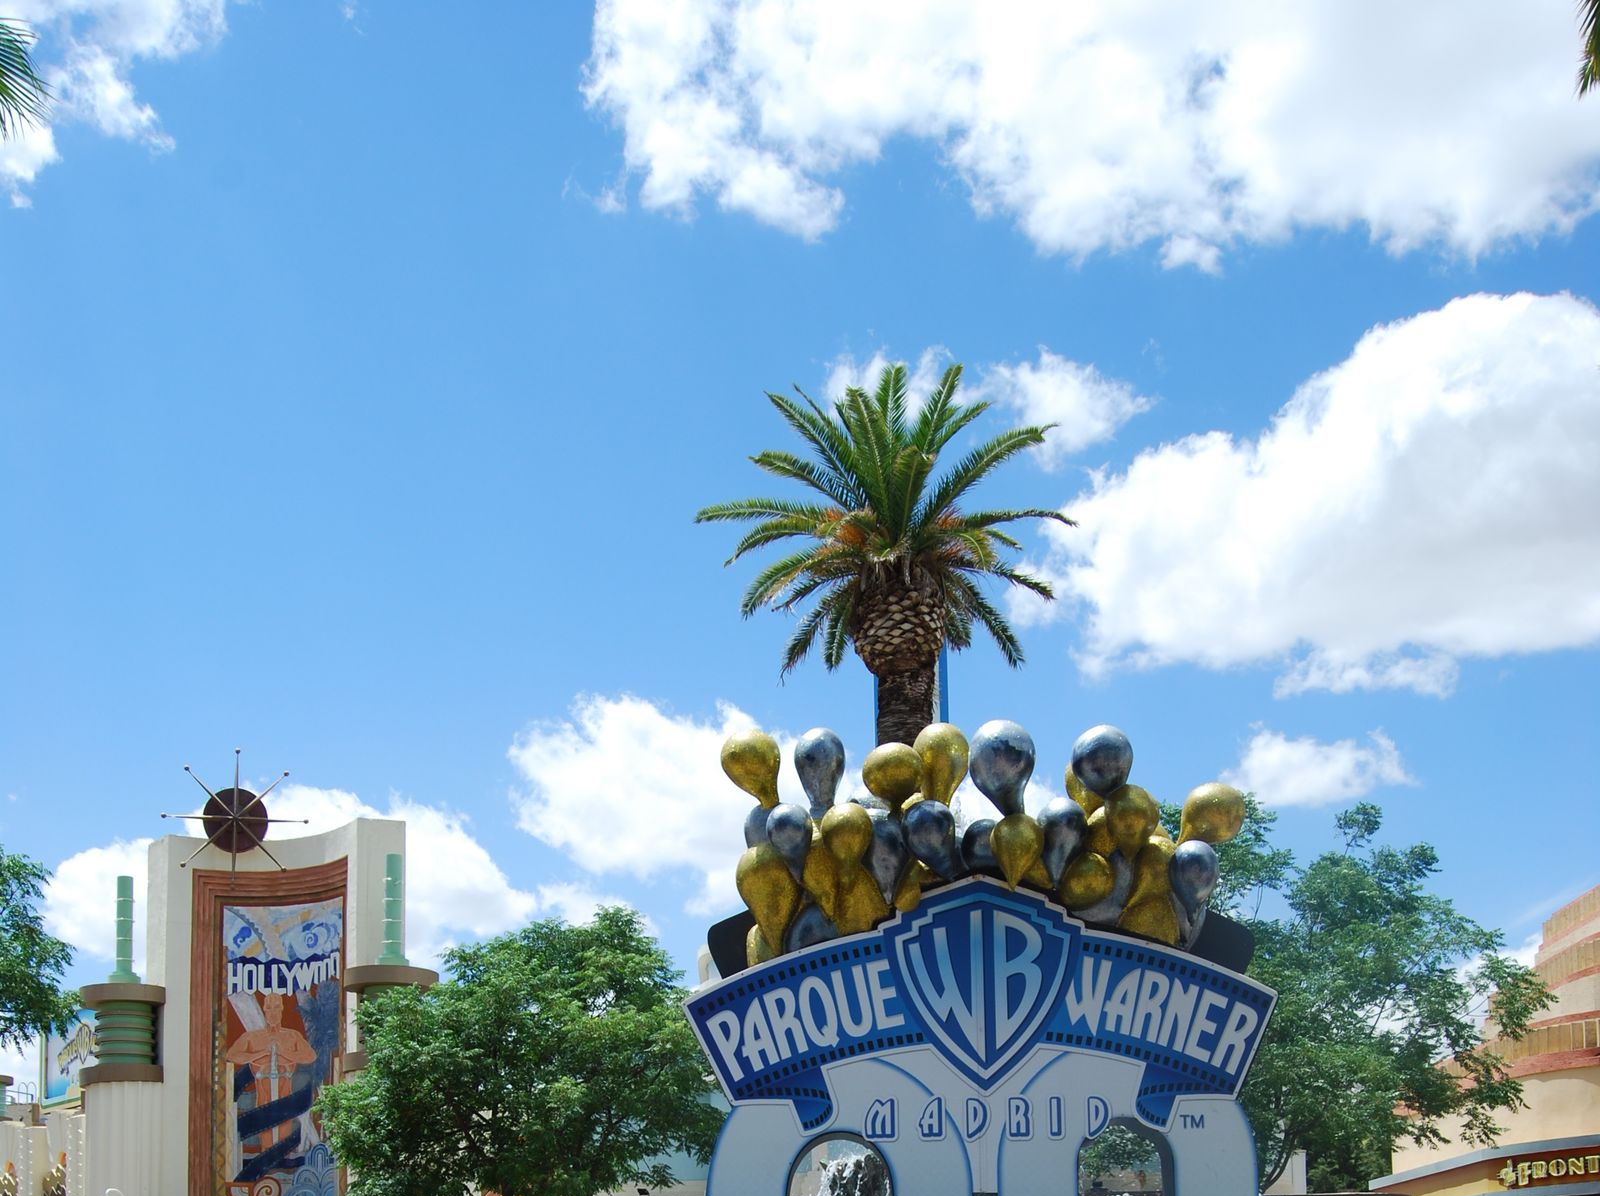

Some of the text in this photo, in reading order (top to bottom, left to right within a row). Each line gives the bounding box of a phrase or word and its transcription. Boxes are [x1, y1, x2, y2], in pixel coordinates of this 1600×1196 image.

[228, 952, 340, 996] HOLLYWOOD
[909, 908, 1042, 1063] WB
[706, 956, 1258, 1082] PARQUE WARNER
[864, 1096, 1109, 1138] MADRID
[1179, 1114, 1205, 1129] TM
